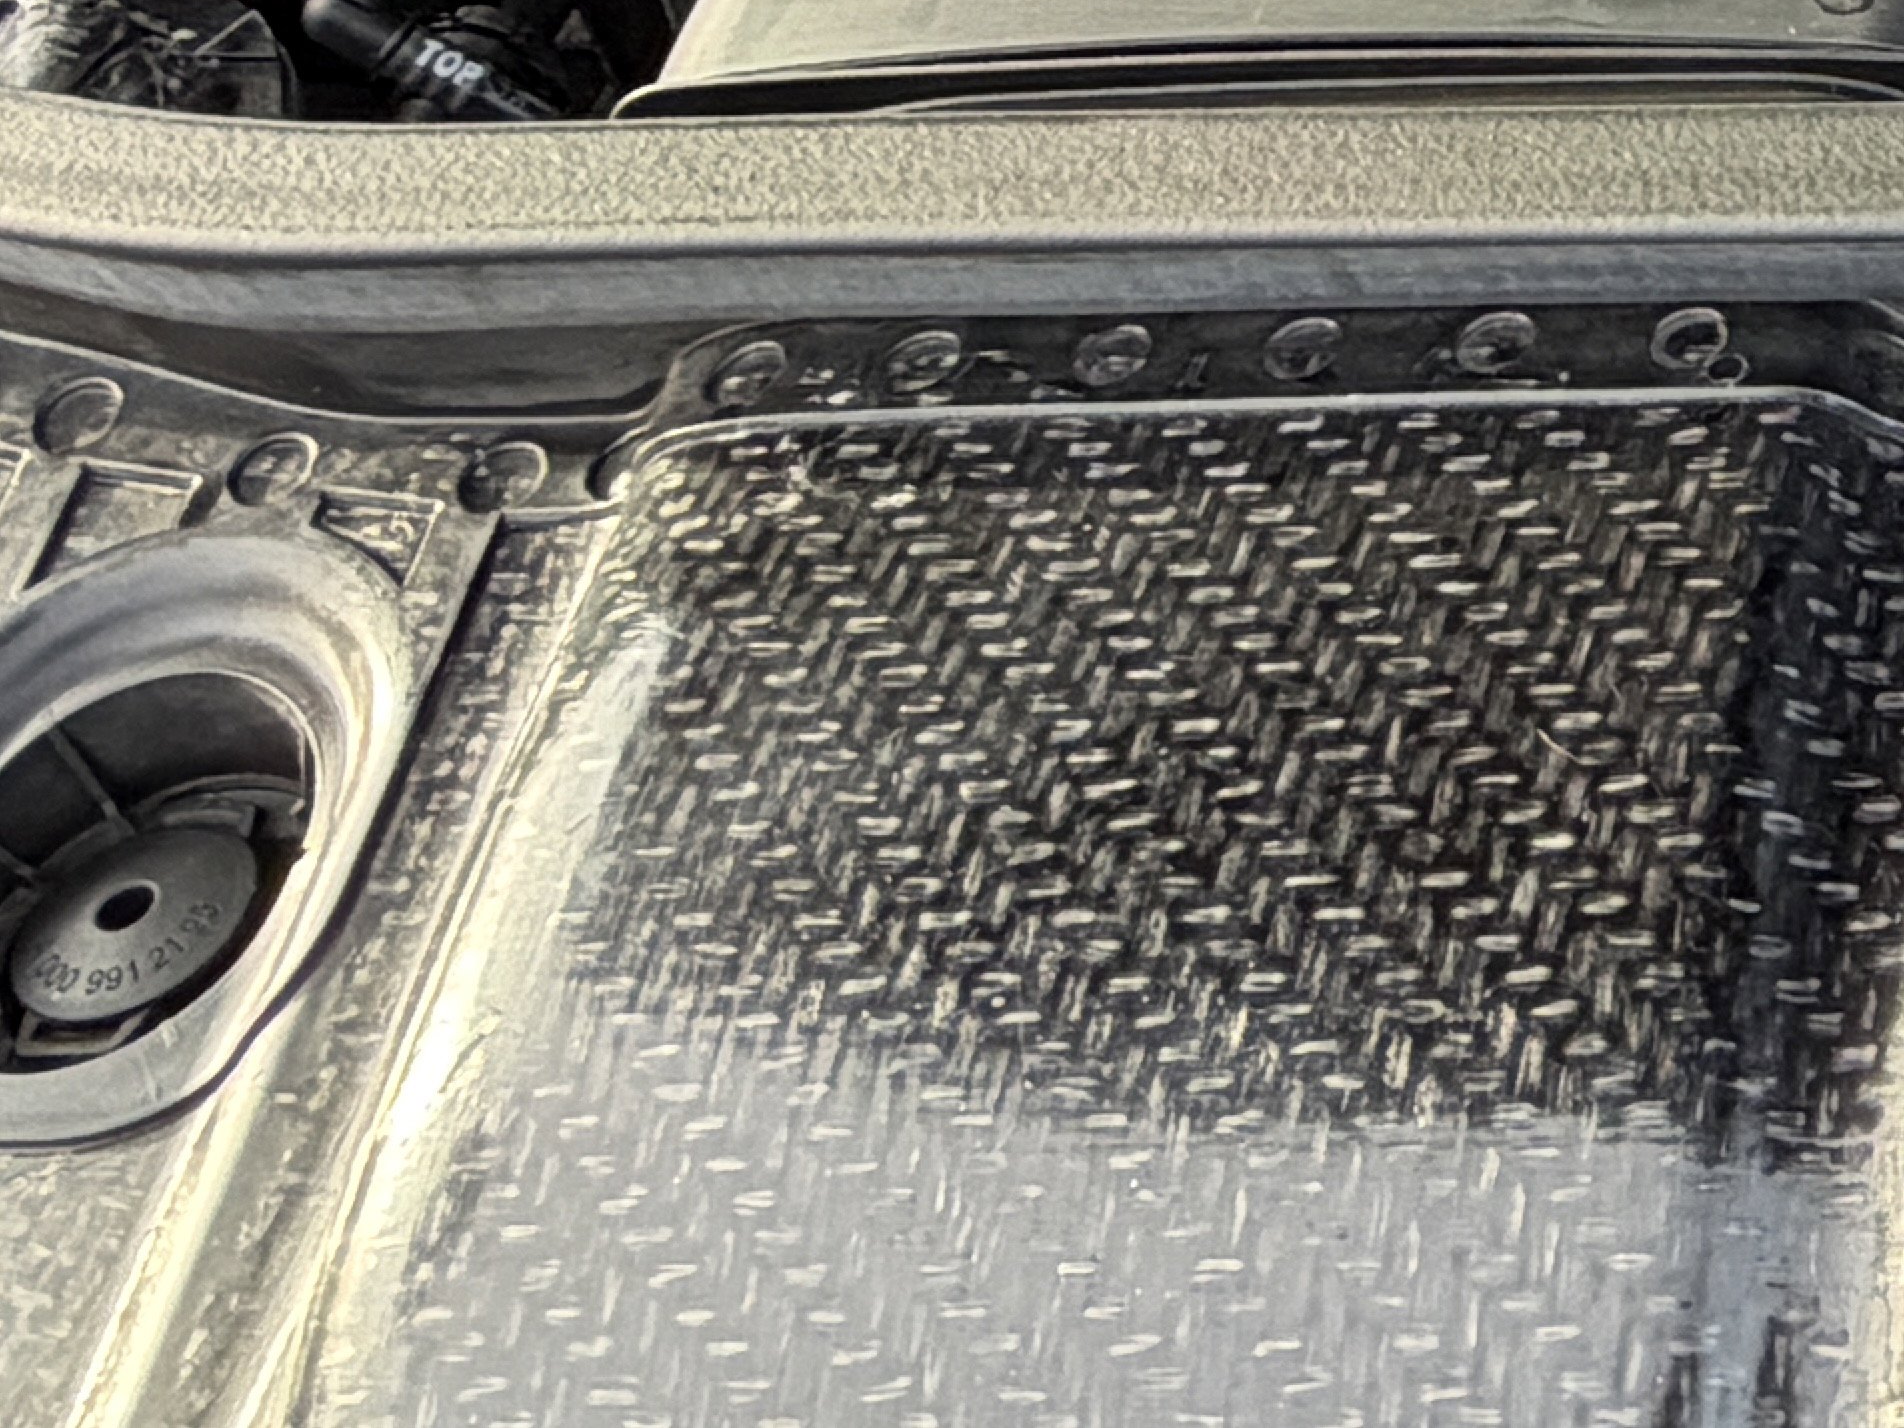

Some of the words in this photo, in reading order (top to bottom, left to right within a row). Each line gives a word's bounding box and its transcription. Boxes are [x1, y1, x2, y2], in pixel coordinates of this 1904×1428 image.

[414, 38, 485, 86] TOP
[85, 958, 139, 995] 991
[150, 936, 184, 971] 21
